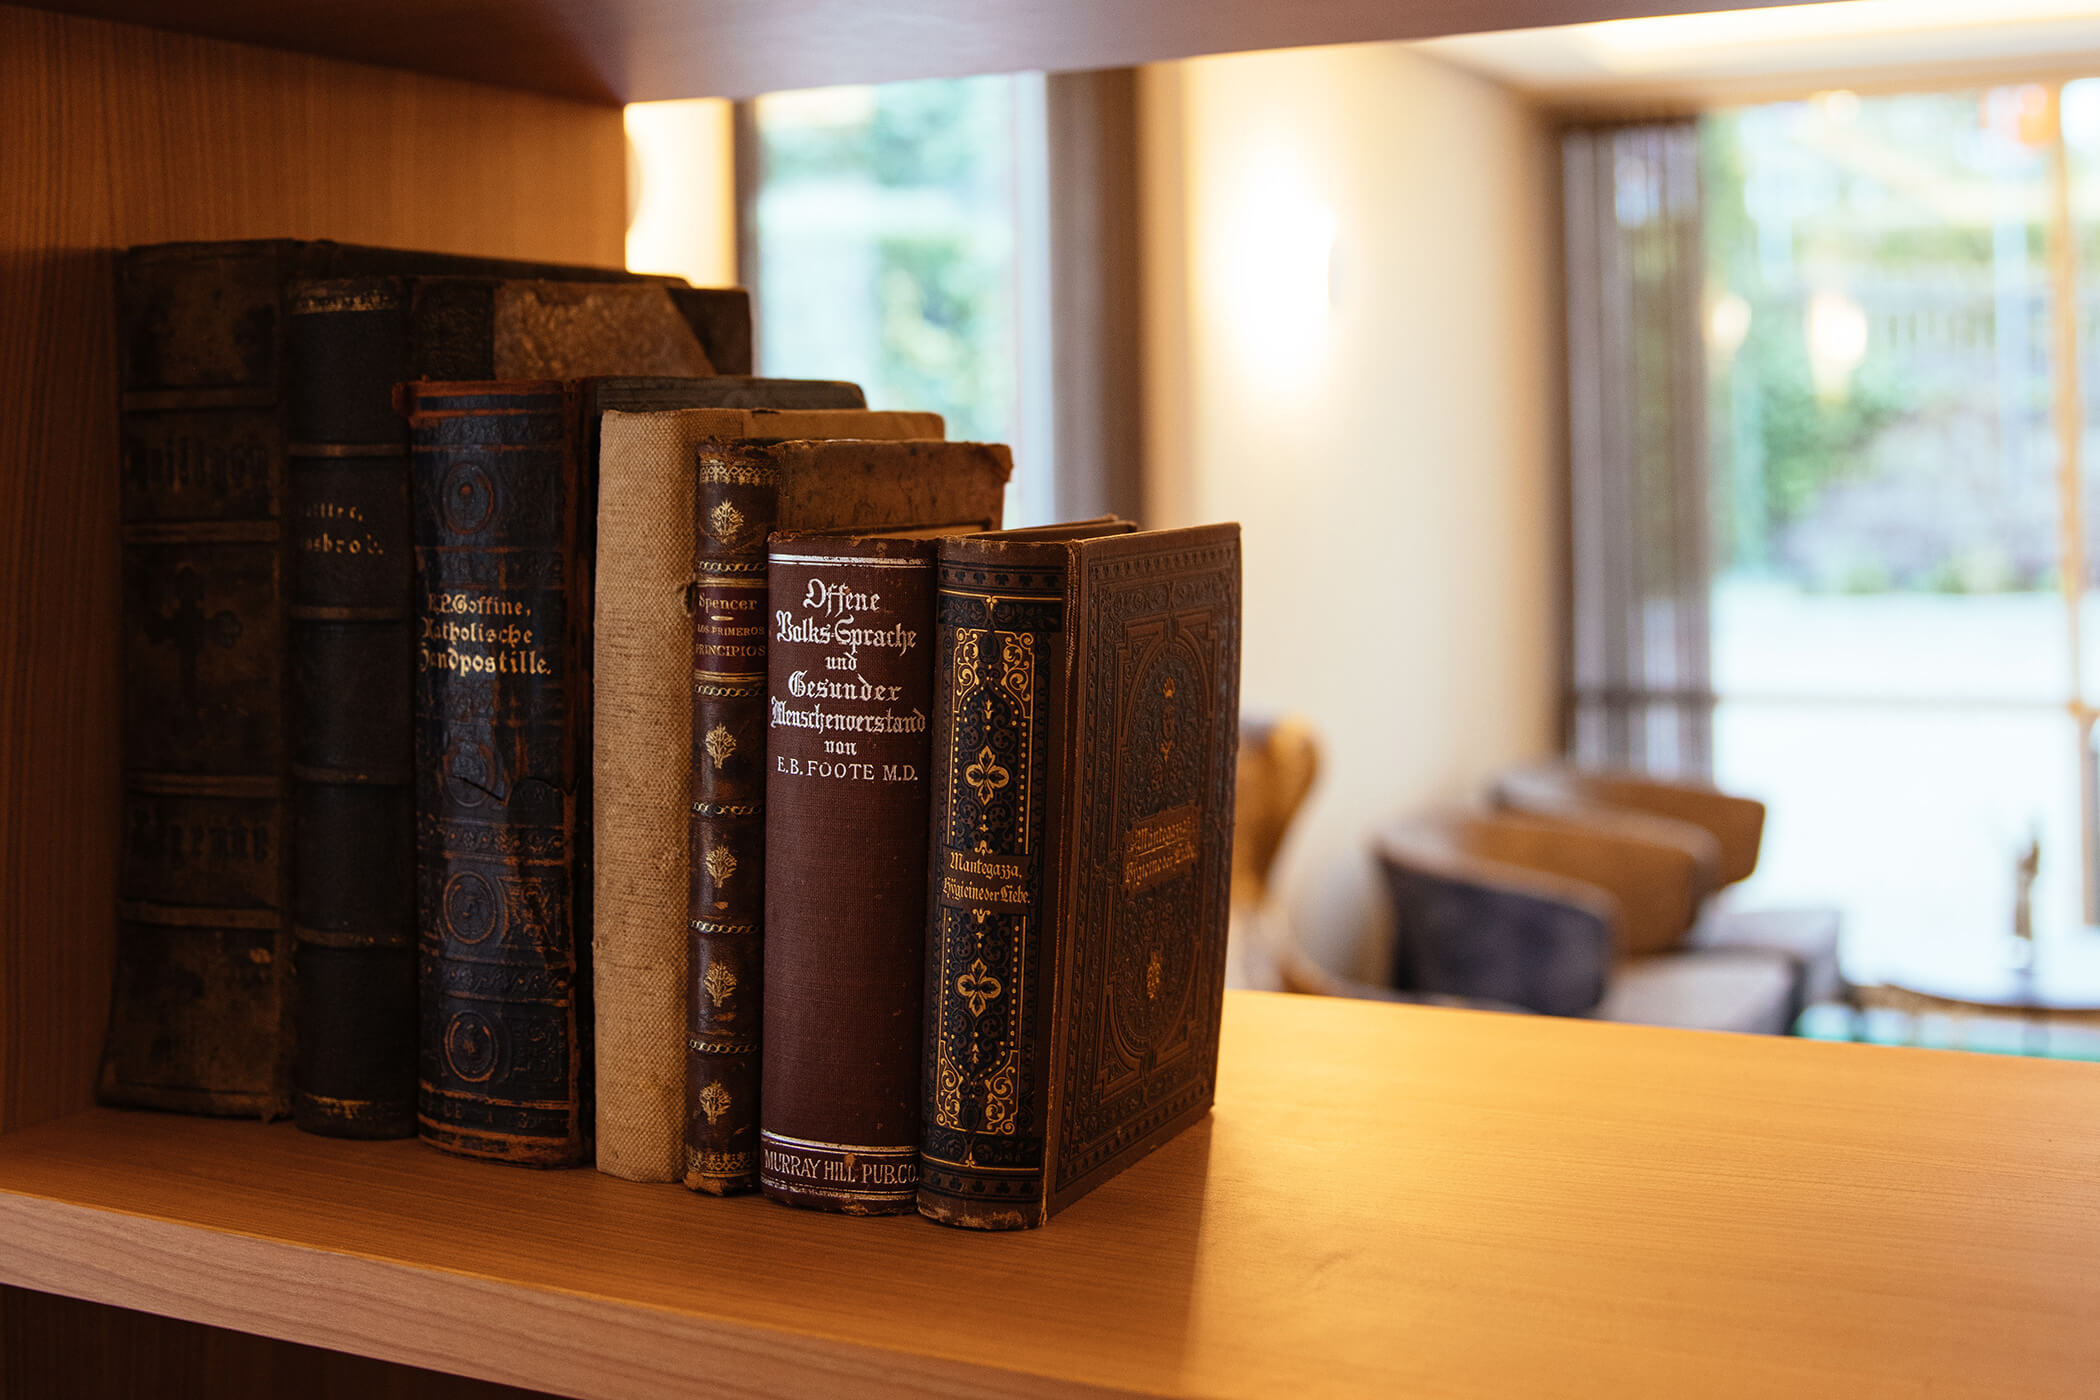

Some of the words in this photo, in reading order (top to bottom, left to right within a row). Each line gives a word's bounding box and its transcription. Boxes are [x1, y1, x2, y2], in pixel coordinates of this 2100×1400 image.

[698, 592, 758, 614] Spencer
[802, 578, 881, 617] Offene
[711, 626, 766, 637] PRIMEROS
[695, 643, 767, 657] PRINCIPIOS
[825, 652, 858, 670] und
[788, 670, 902, 701] Gesunder
[770, 696, 926, 734] Menschenverstand
[824, 740, 857, 756] von
[807, 760, 875, 781] FOOTE
[882, 764, 919, 781] M.D.
[950, 852, 1022, 880] Mantegazza.
[764, 1149, 821, 1179] MURRAY
[823, 1159, 856, 1183] HILL
